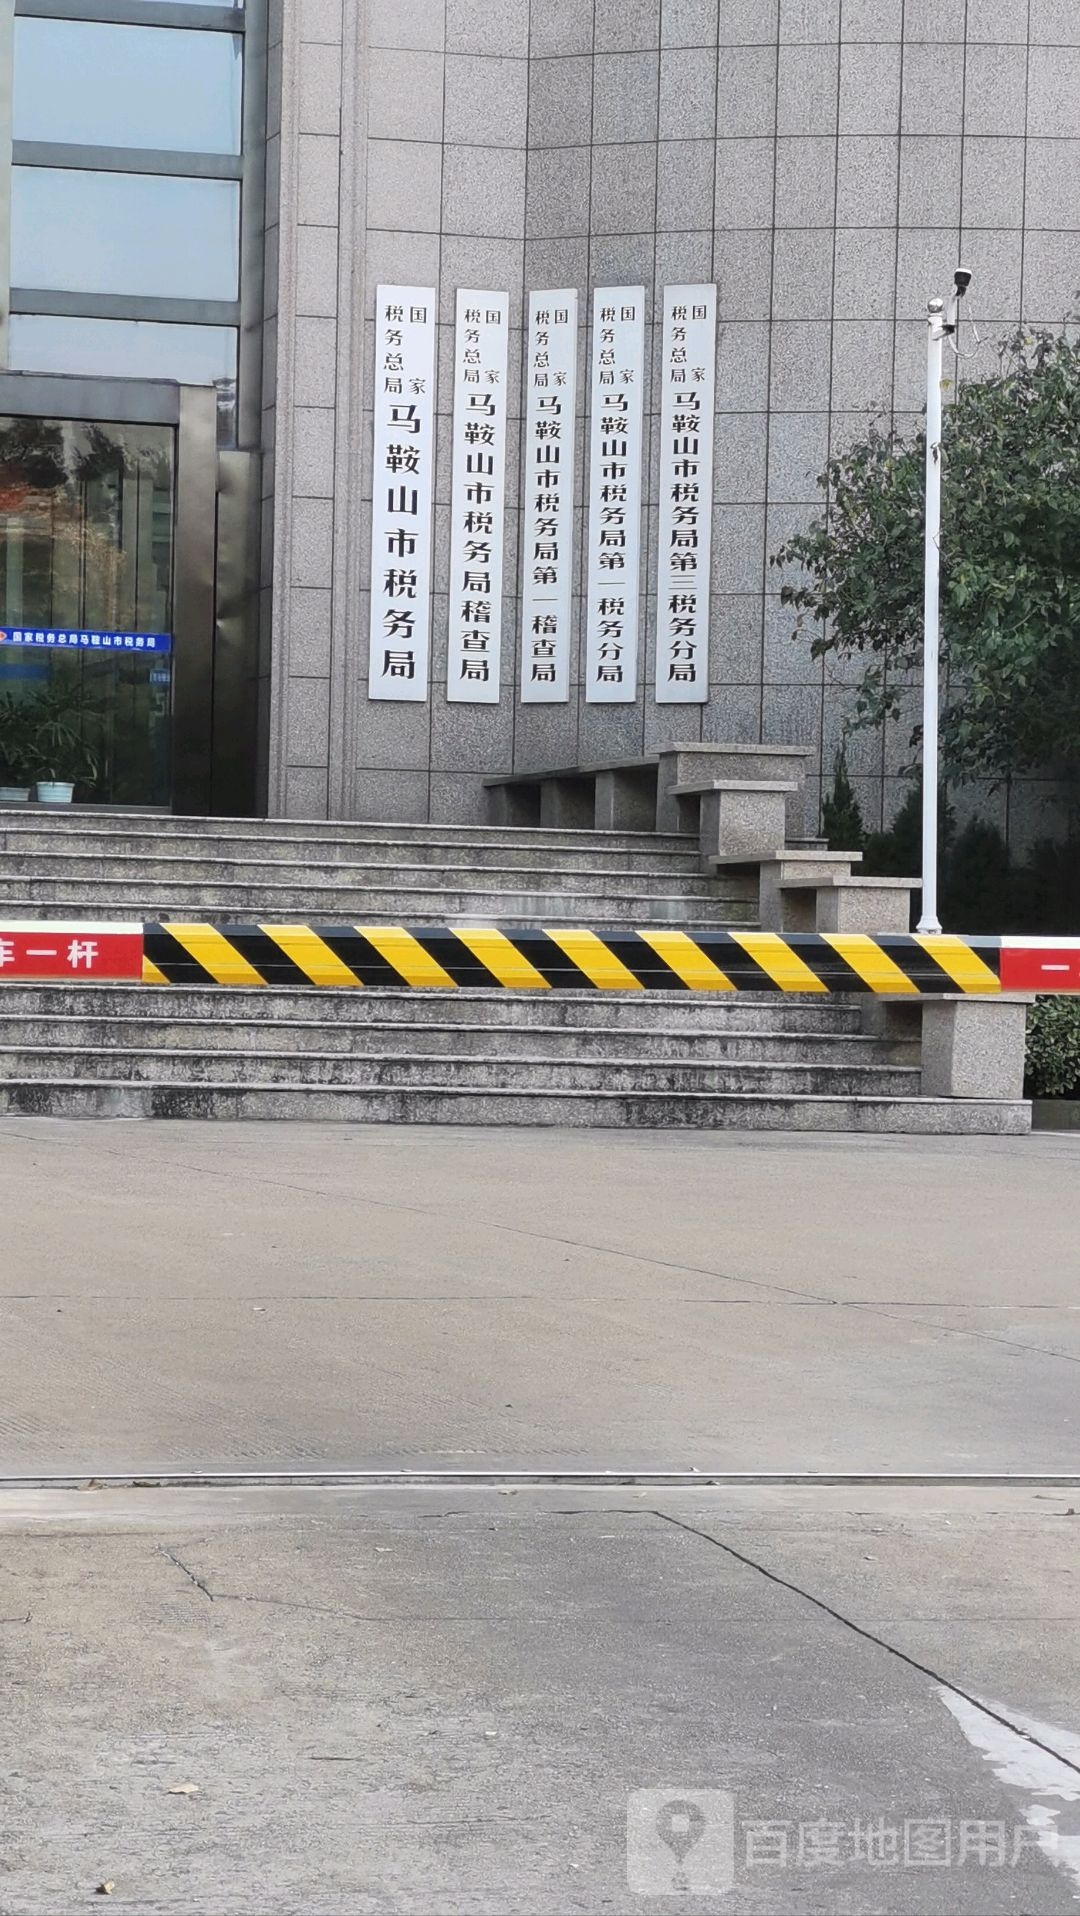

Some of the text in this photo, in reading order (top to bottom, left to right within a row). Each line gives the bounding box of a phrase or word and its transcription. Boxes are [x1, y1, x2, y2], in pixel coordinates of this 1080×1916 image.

[384, 305, 404, 395] 税务总局
[409, 306, 426, 394] 国家
[463, 308, 481, 384] 税务总局
[485, 310, 501, 384] 国家
[534, 310, 550, 388] 税务总局
[553, 309, 568, 386] 国家
[599, 306, 616, 385] 税务总局
[620, 306, 636, 384] 国家
[670, 305, 688, 384] 税务总局
[691, 305, 707, 382] 国家
[382, 404, 421, 679] 马鞍山市税务局
[460, 393, 496, 682] 马鞍山市税务局稽查局
[530, 396, 562, 682] 马鞍山市税务局第一稽查局
[596, 393, 629, 683] 马鞍山市税务局第一税务分局
[667, 391, 702, 682] 马鞍山市税务局第三税务分局
[12, 631, 156, 648] 国家税务总局马鞍山市税务局
